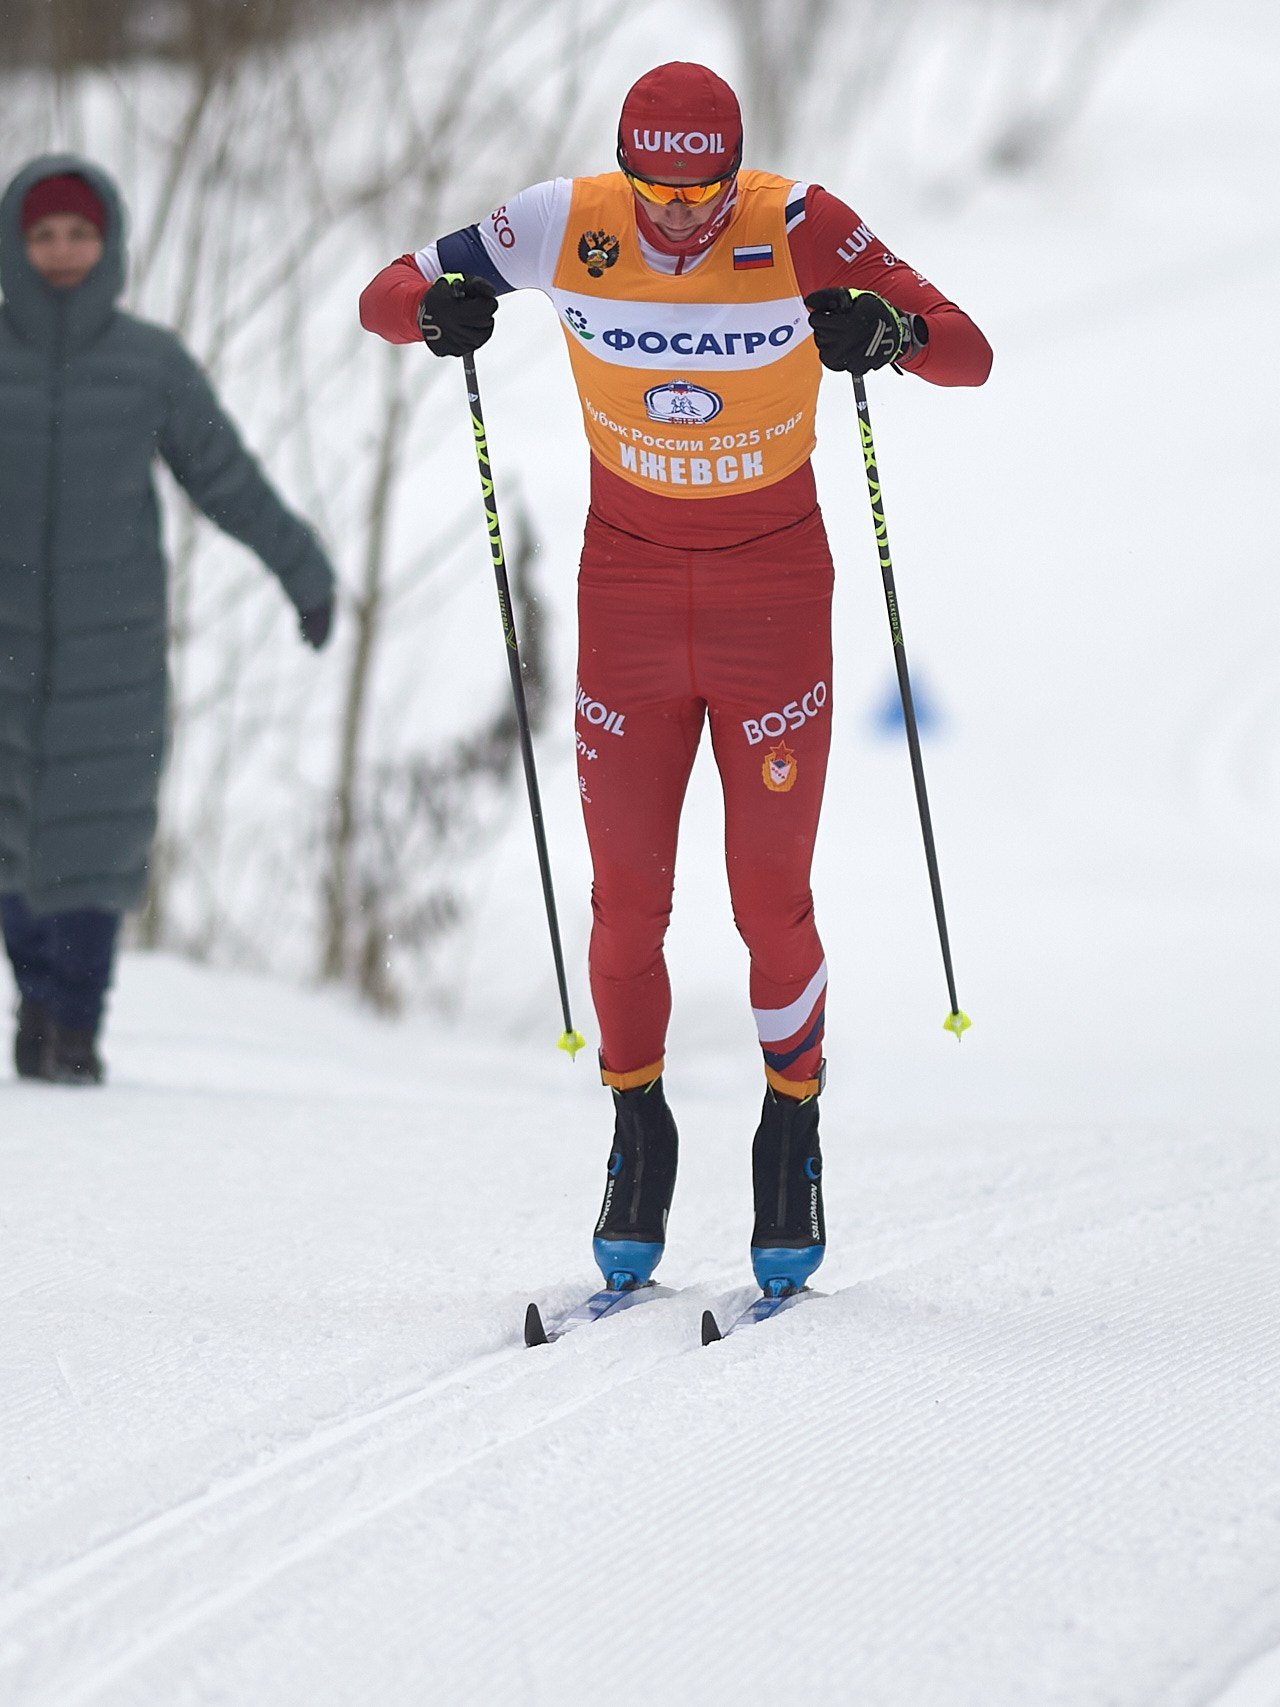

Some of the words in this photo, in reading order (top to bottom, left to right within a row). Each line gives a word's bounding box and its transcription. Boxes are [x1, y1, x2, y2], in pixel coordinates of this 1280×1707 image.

[633, 128, 725, 154] LUKOIL
[491, 205, 516, 249] SCO
[836, 223, 875, 264] LUK
[602, 324, 795, 356] ФОСАГРО
[584, 397, 629, 438] Кубок
[631, 427, 704, 452] России
[709, 429, 761, 451] 2025
[765, 411, 803, 440] года
[619, 441, 764, 486] ИЖЕВСК
[742, 680, 827, 746] BOSCO
[810, 1183, 820, 1240] SALOMON
